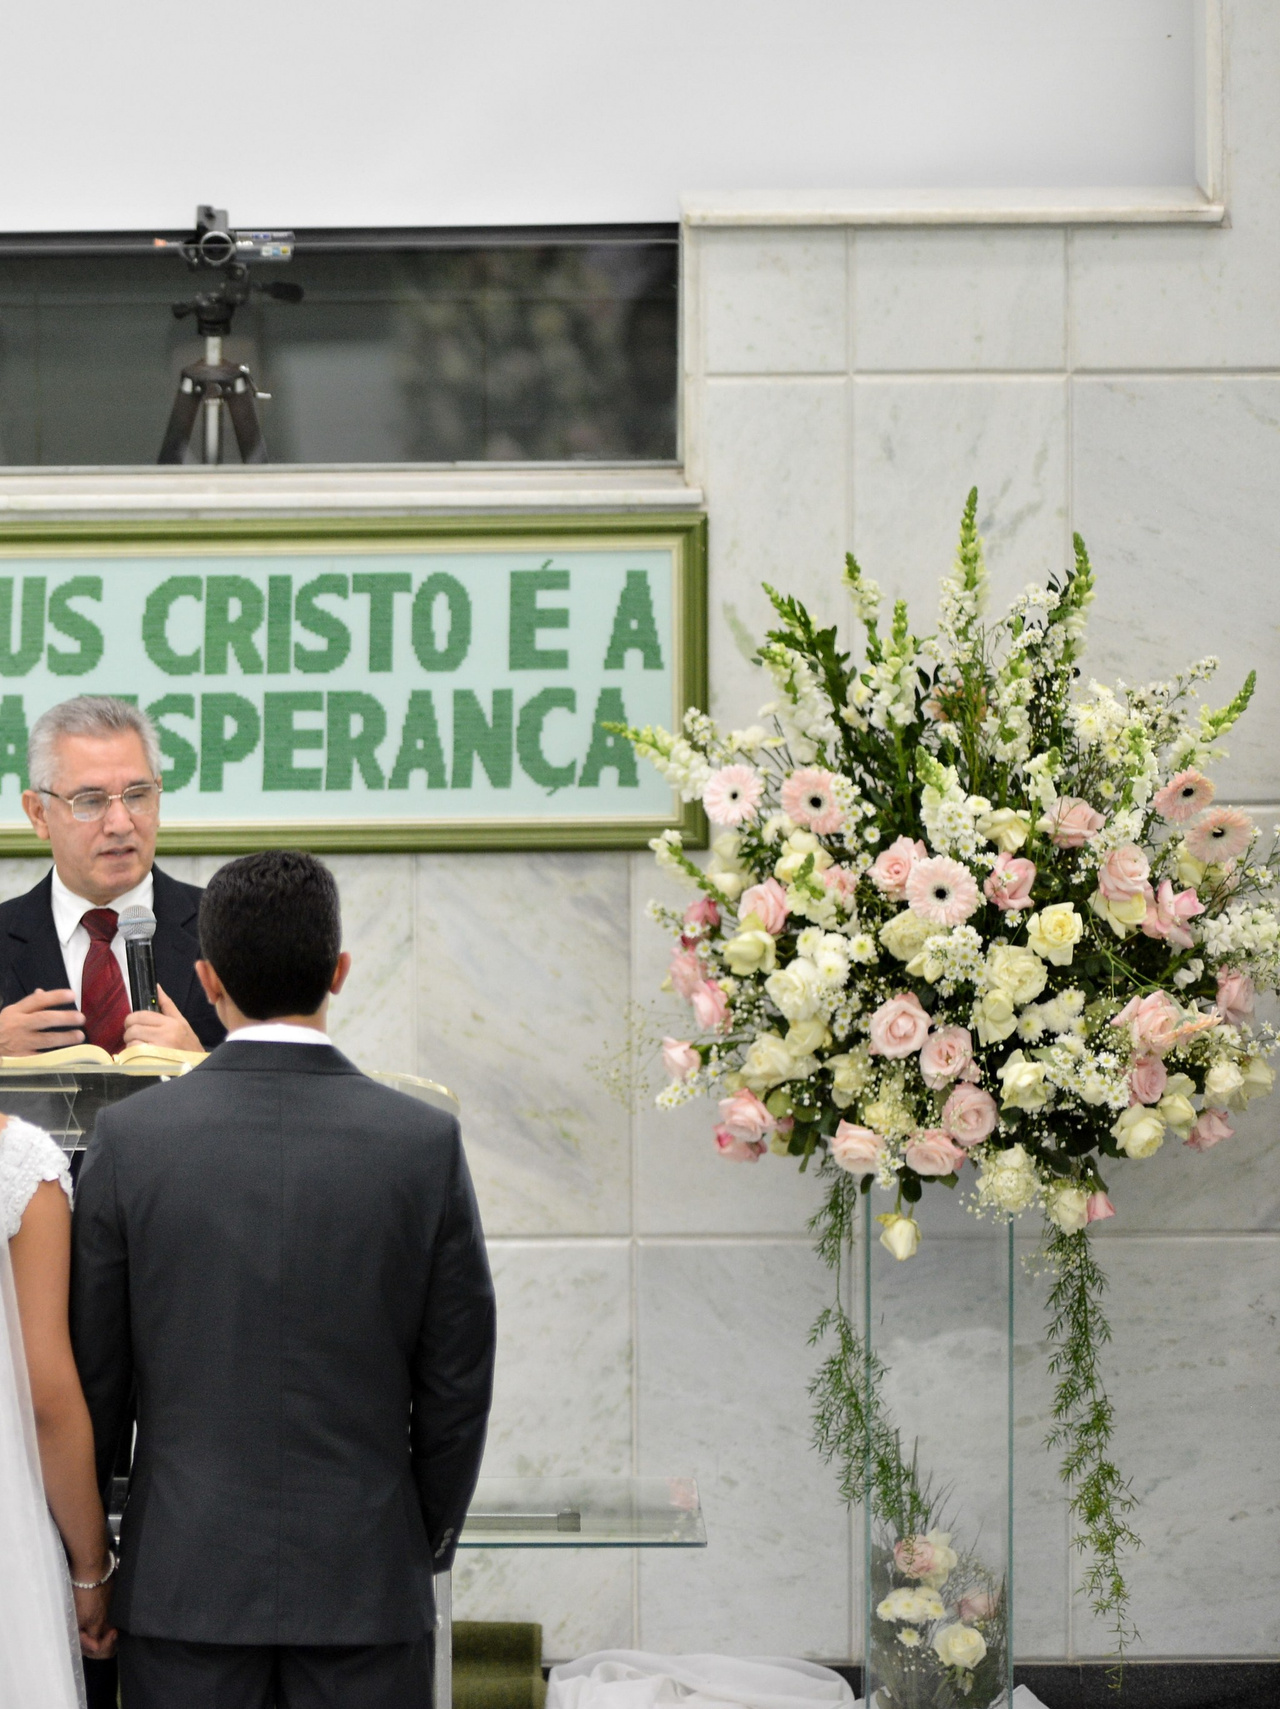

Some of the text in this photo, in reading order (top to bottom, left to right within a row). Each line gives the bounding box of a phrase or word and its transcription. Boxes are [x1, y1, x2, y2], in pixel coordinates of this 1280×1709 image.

[141, 571, 473, 677] CRISTO
[508, 559, 571, 672] É
[603, 569, 665, 671] A
[77, 686, 640, 797] SPERANÇA
